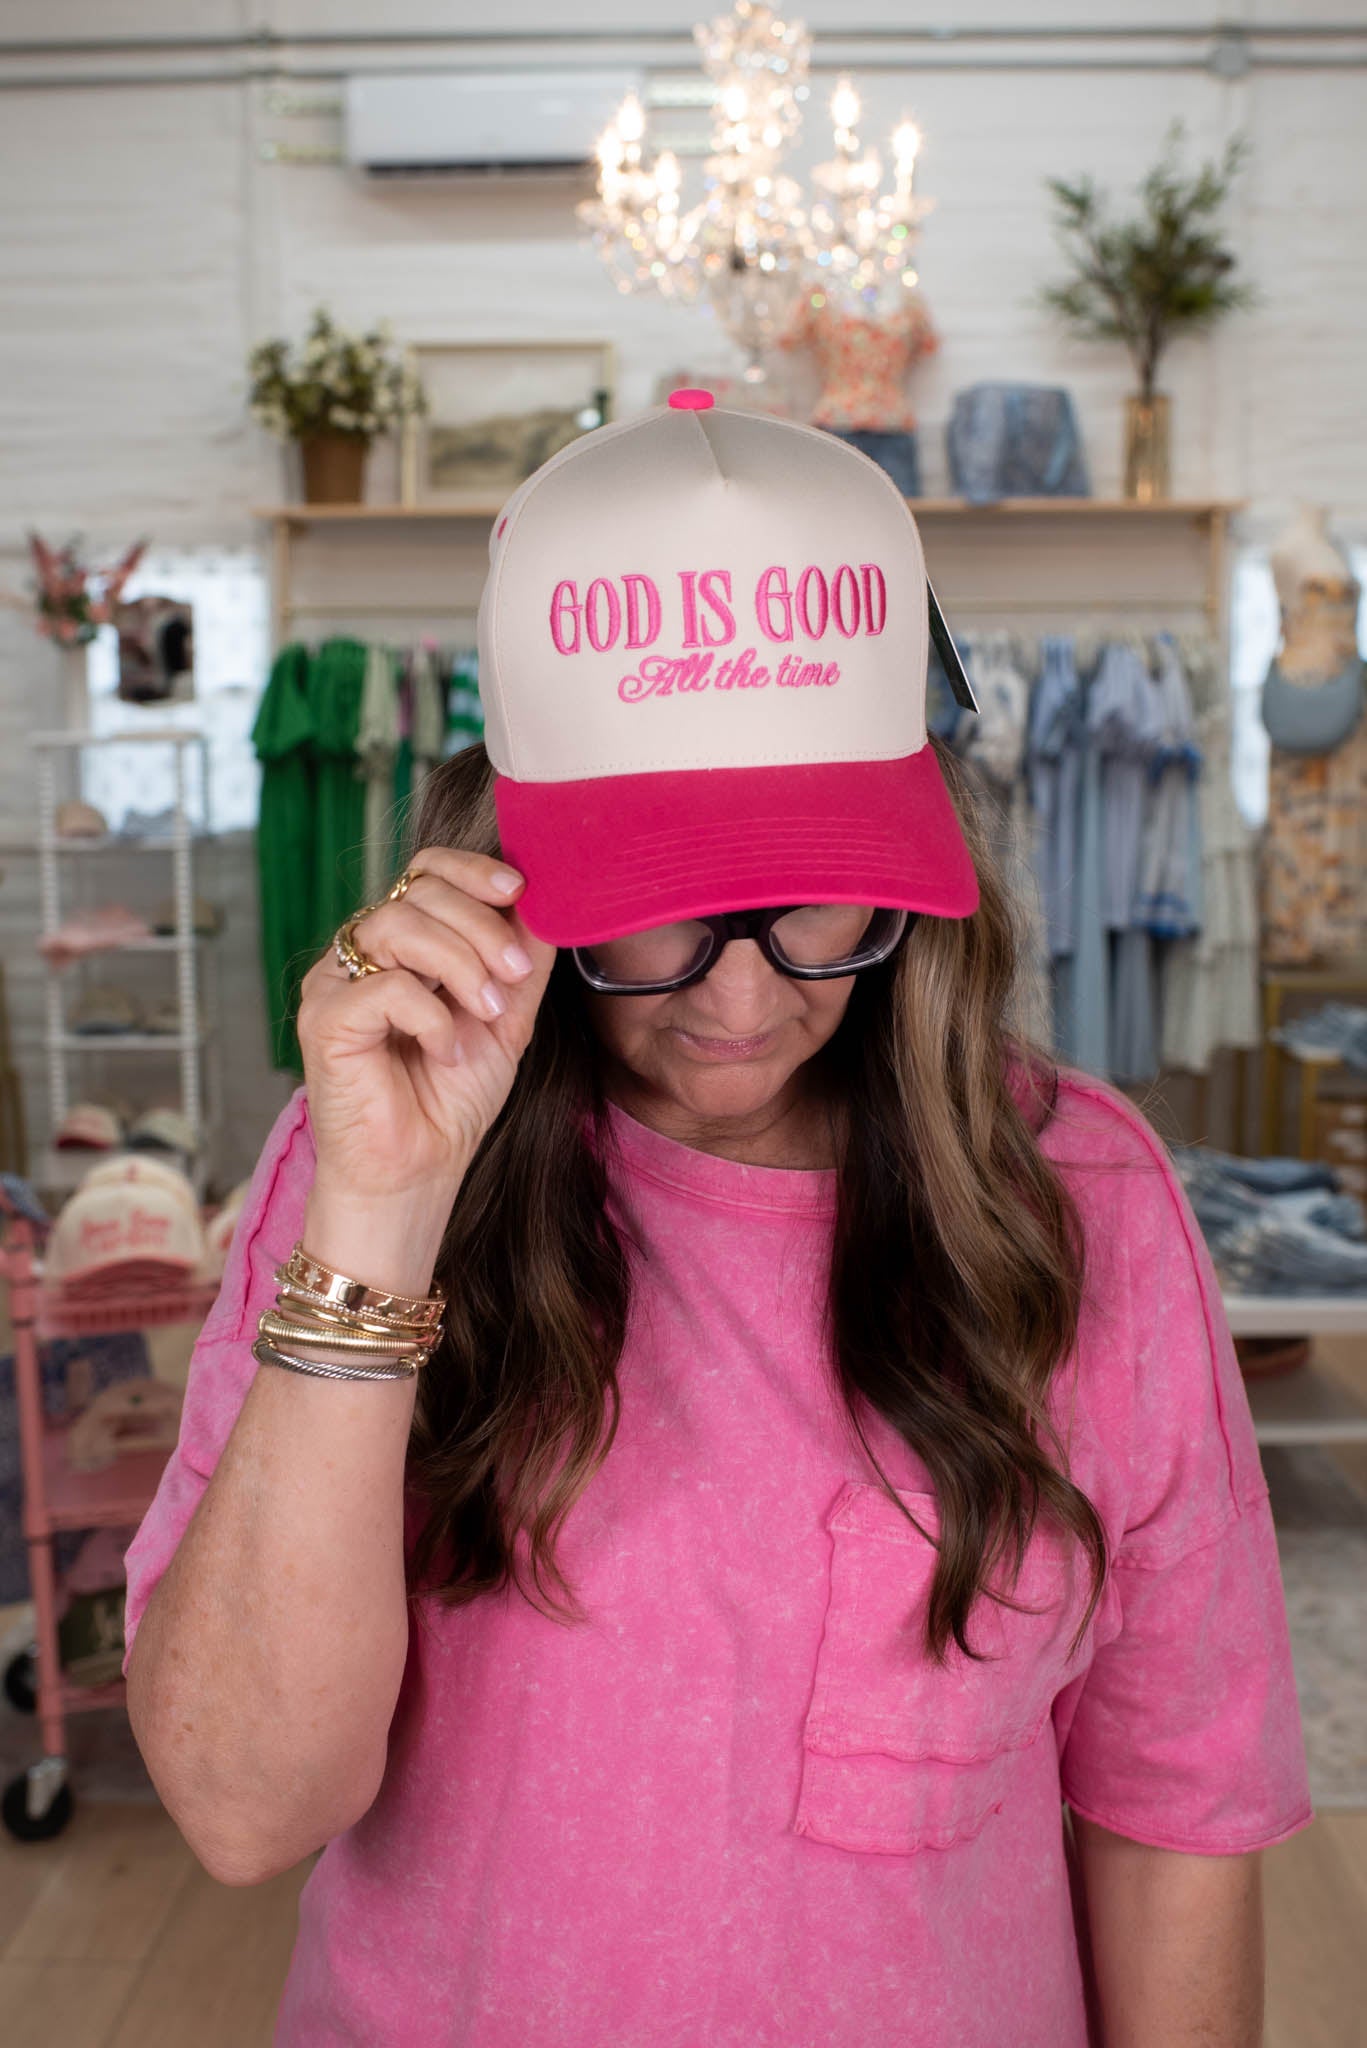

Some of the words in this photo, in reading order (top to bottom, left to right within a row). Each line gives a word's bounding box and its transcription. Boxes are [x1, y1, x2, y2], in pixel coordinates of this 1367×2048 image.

[549, 574, 662, 656] GOD
[677, 570, 736, 649] IS
[755, 563, 886, 642] GOOD
[618, 652, 715, 703] All
[716, 648, 771, 690] the
[776, 654, 841, 688] time
